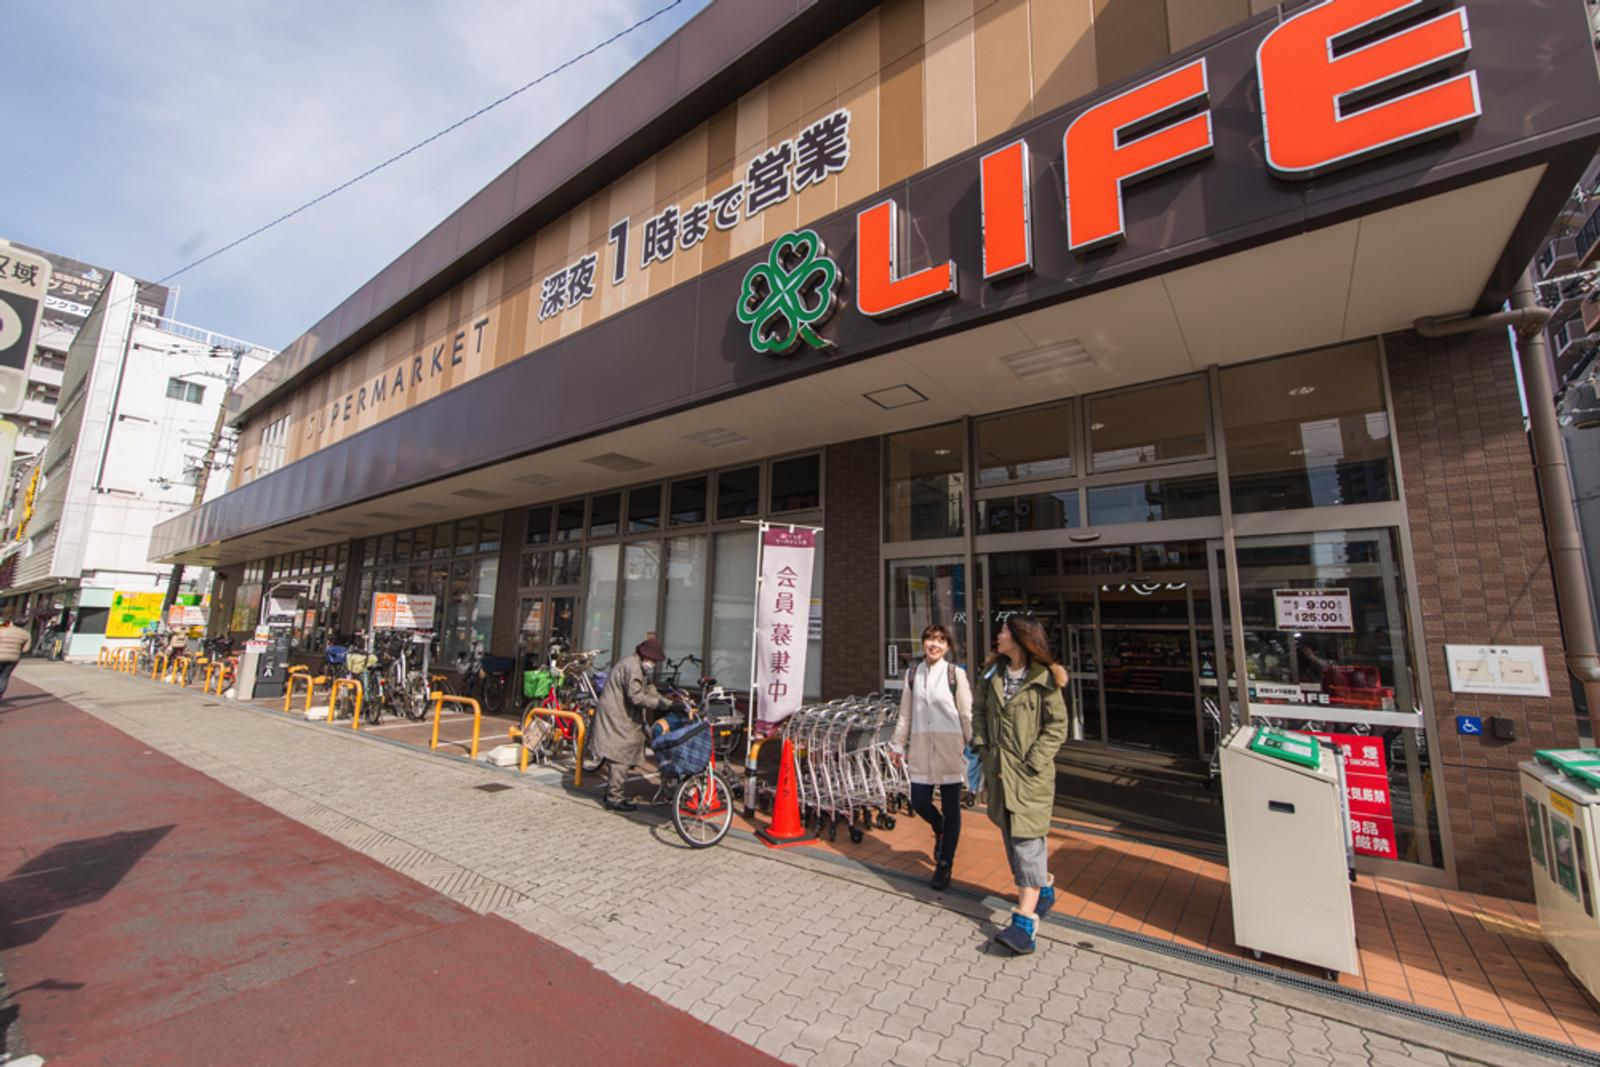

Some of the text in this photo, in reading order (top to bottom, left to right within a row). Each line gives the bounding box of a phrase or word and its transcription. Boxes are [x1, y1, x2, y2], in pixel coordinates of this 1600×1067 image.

[856, 0, 1483, 317] LIFE
[538, 108, 851, 321] 深夜1時まで営業
[305, 317, 490, 440] SUPERMARKET
[1306, 600, 1336, 610] 9:00
[1301, 612, 1338, 623] 25:00
[1349, 758, 1380, 769] SMOKING
[1352, 834, 1391, 853] 厳禁
